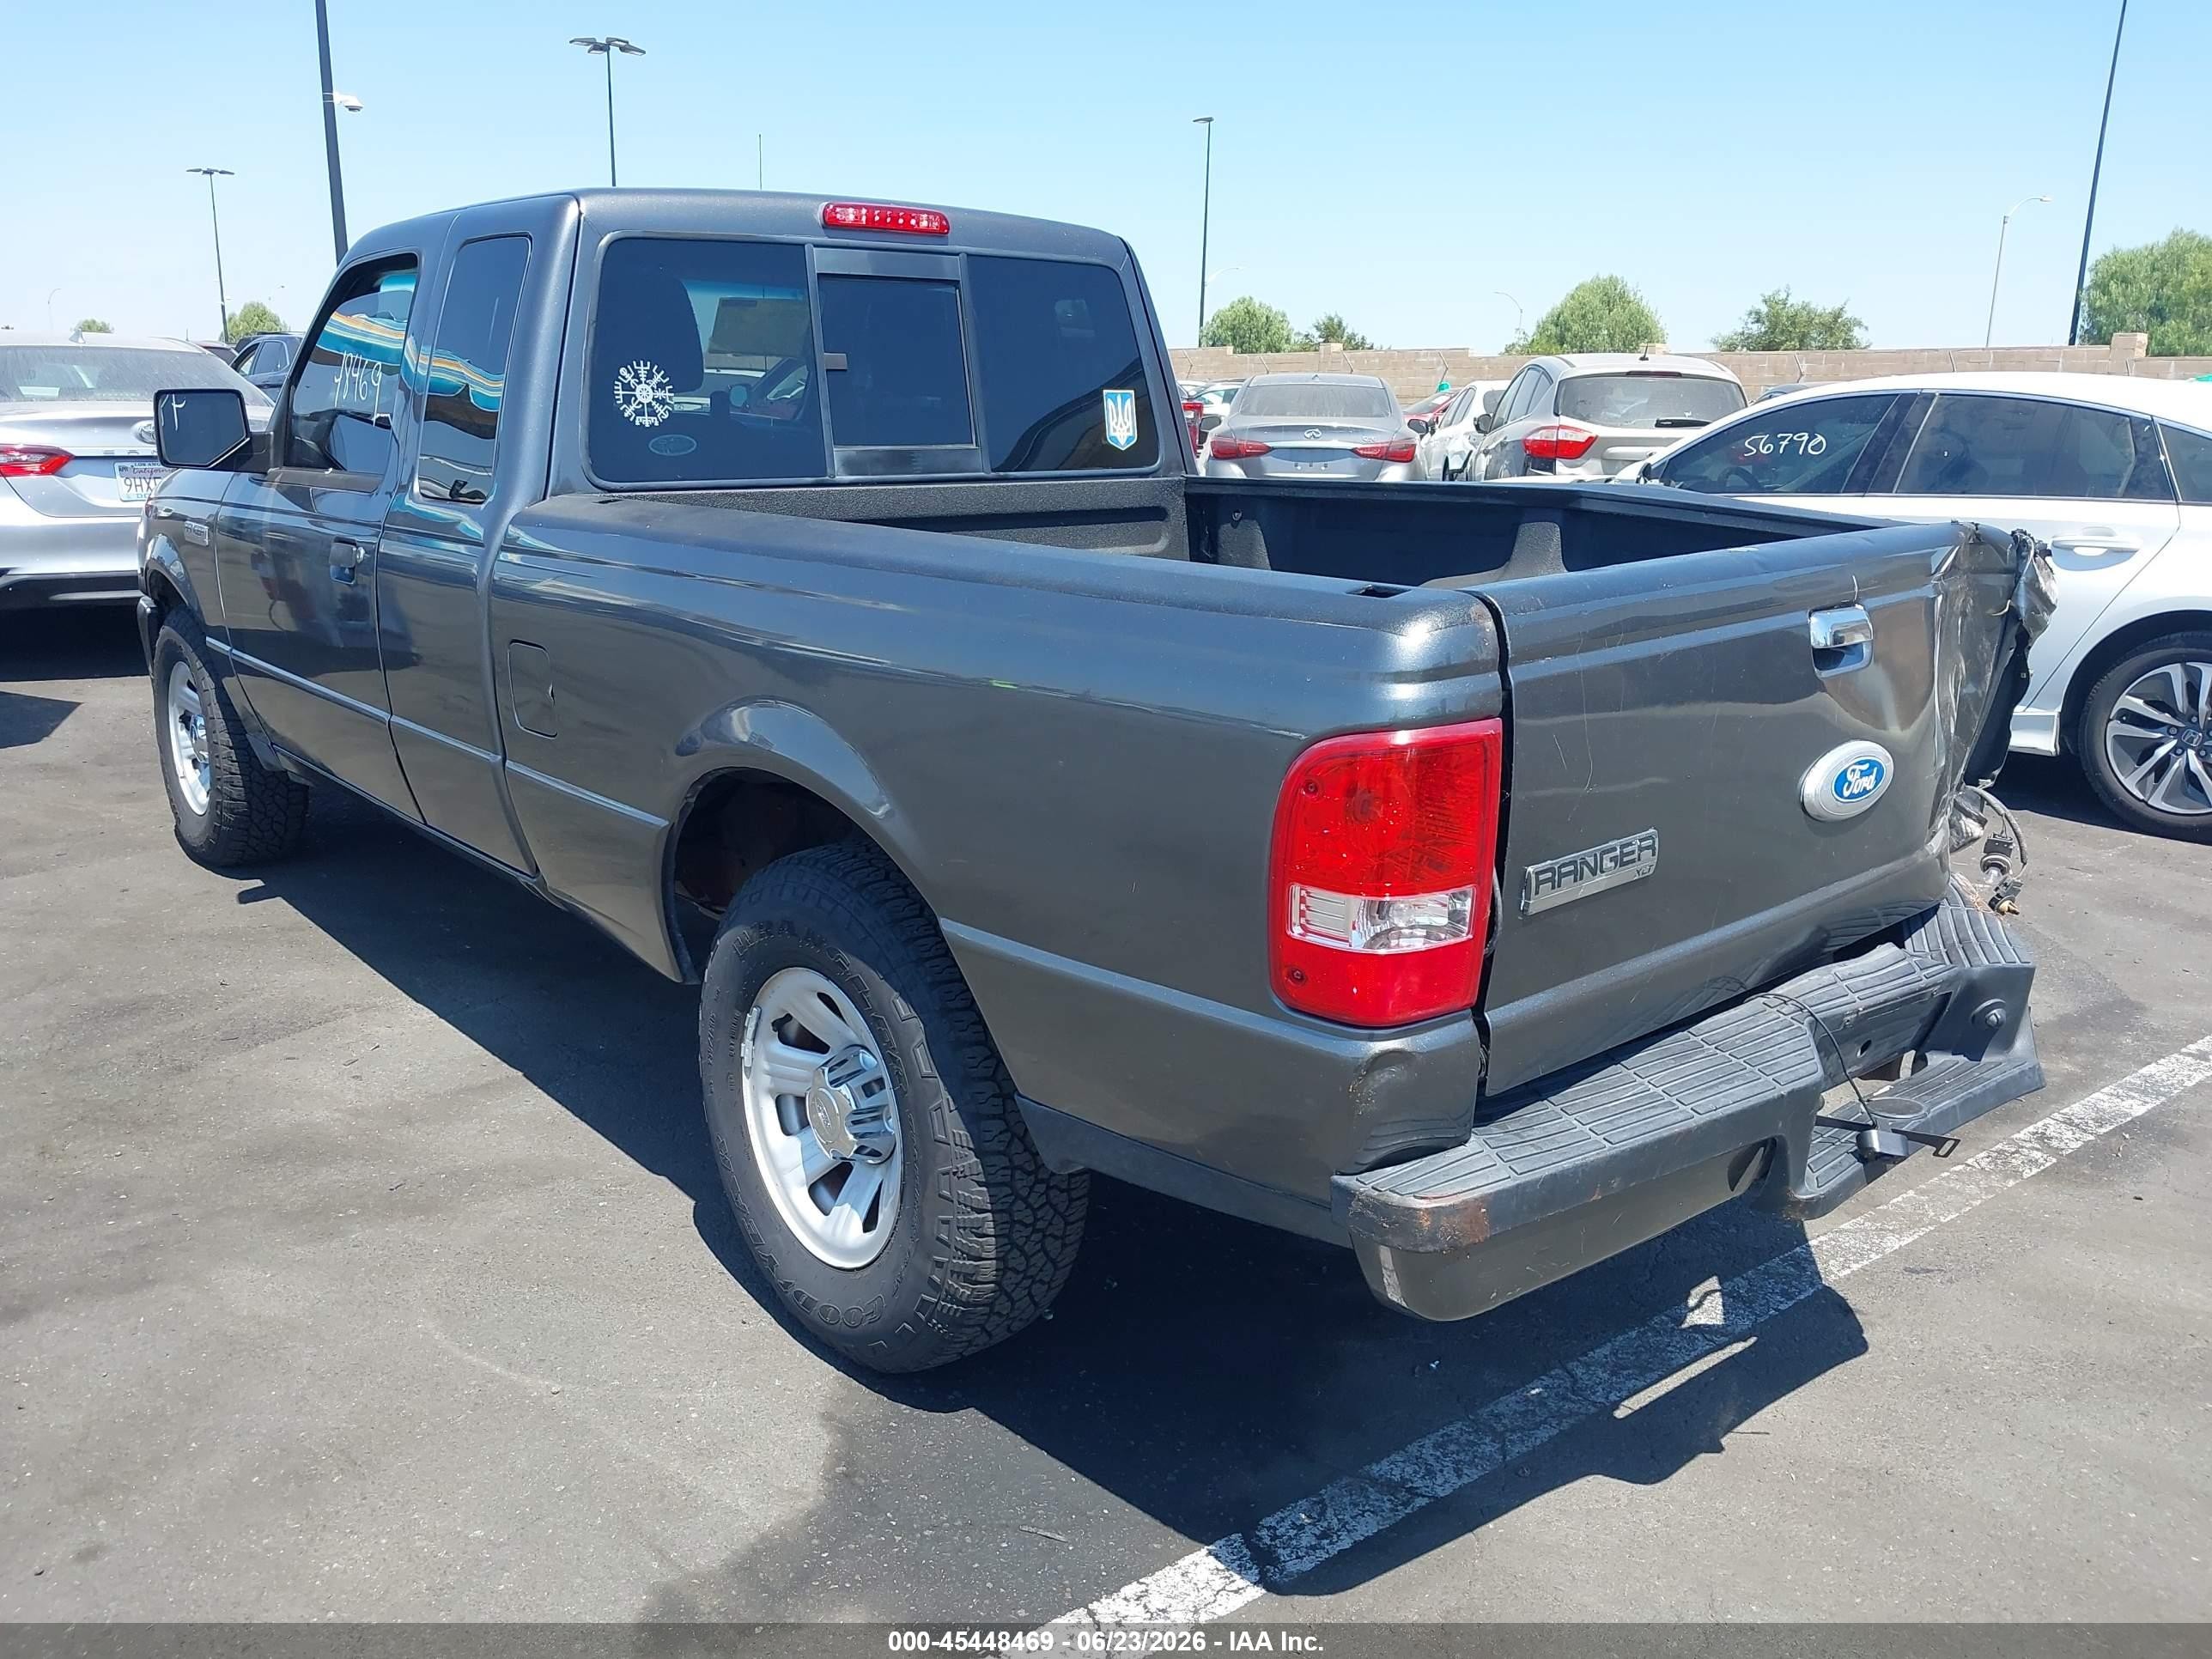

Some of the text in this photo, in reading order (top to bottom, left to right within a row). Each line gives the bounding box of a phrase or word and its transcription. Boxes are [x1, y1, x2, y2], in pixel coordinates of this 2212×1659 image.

[1743, 432, 1826, 457] 56790
[1843, 763, 1878, 797] Ford
[1534, 836, 1656, 896] RANGER
[1633, 864, 1654, 878] XLT
